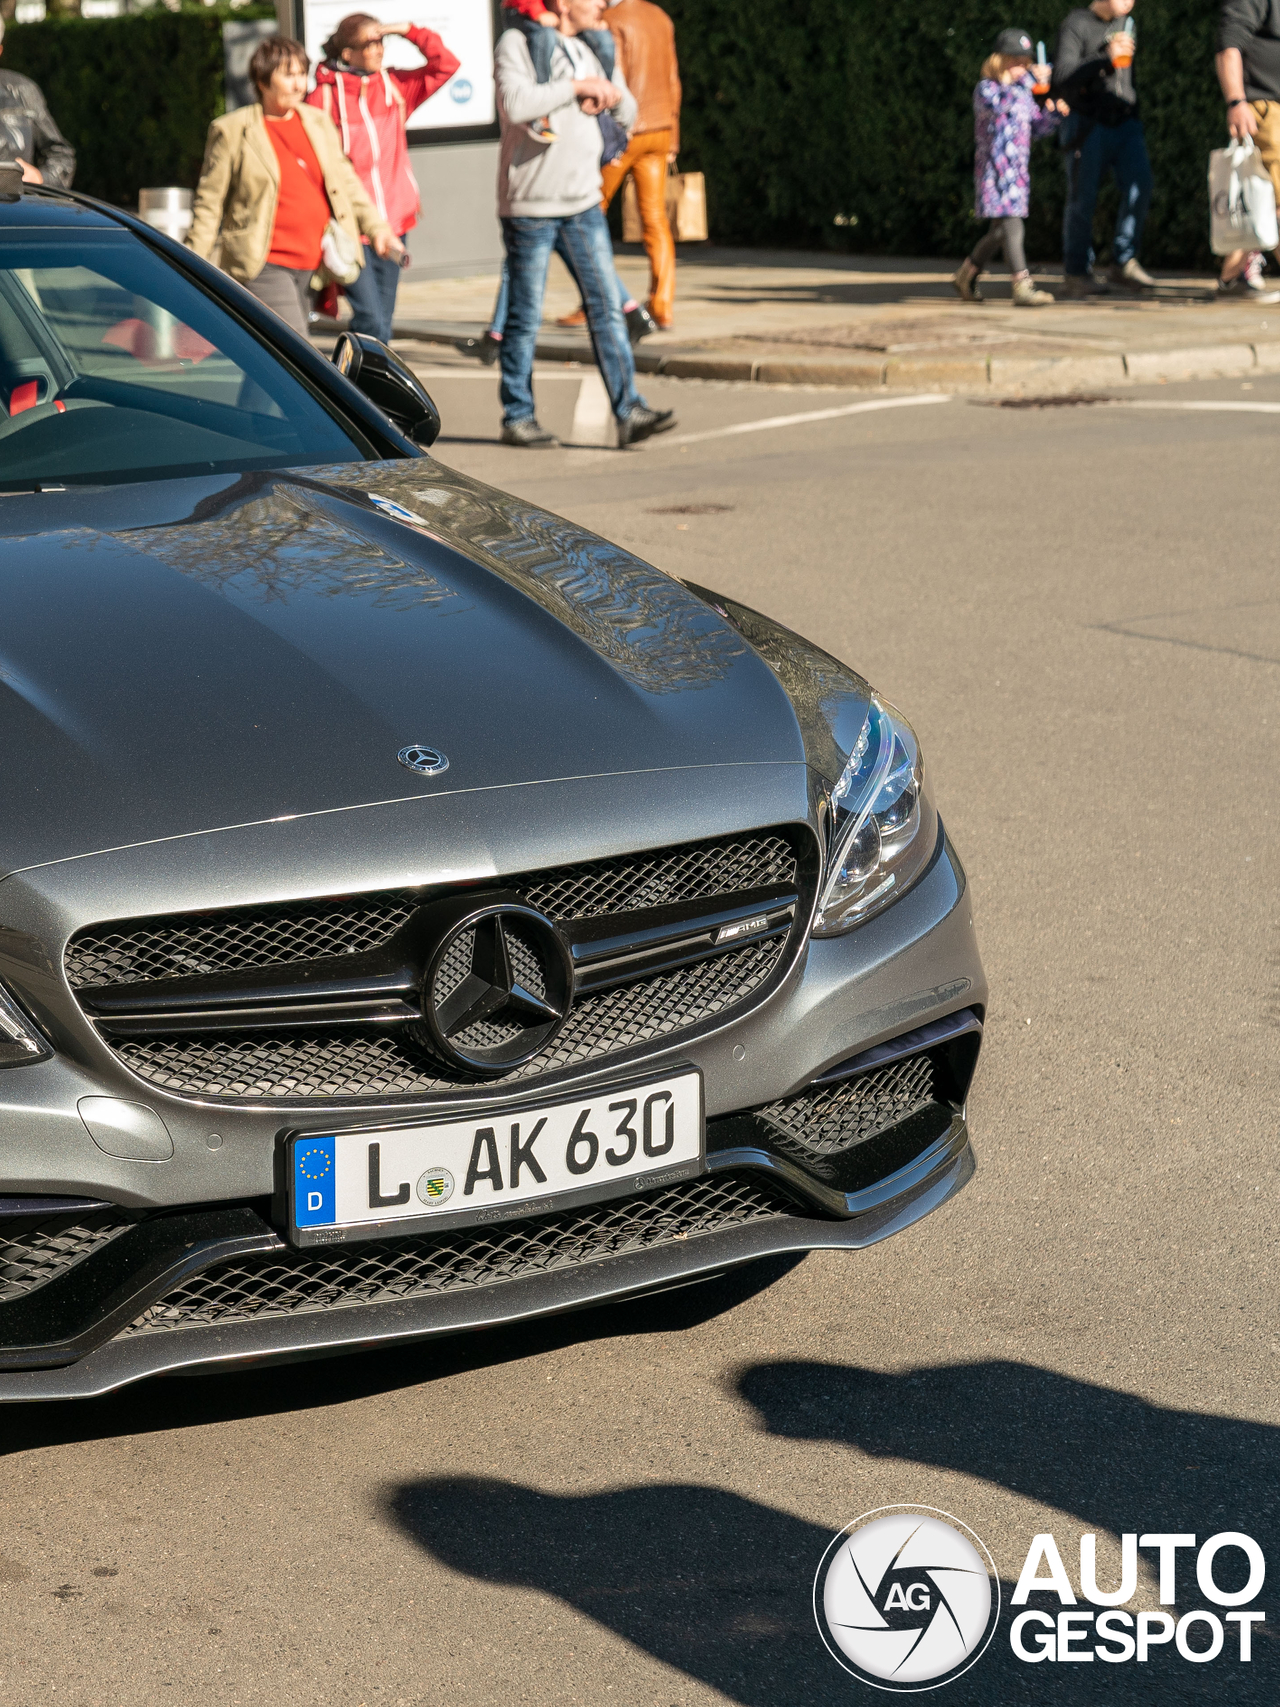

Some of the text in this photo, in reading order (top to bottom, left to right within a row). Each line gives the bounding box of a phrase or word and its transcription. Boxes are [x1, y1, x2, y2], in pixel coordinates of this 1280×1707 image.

[368, 1089, 675, 1209] L AK 630
[307, 1191, 323, 1211] D
